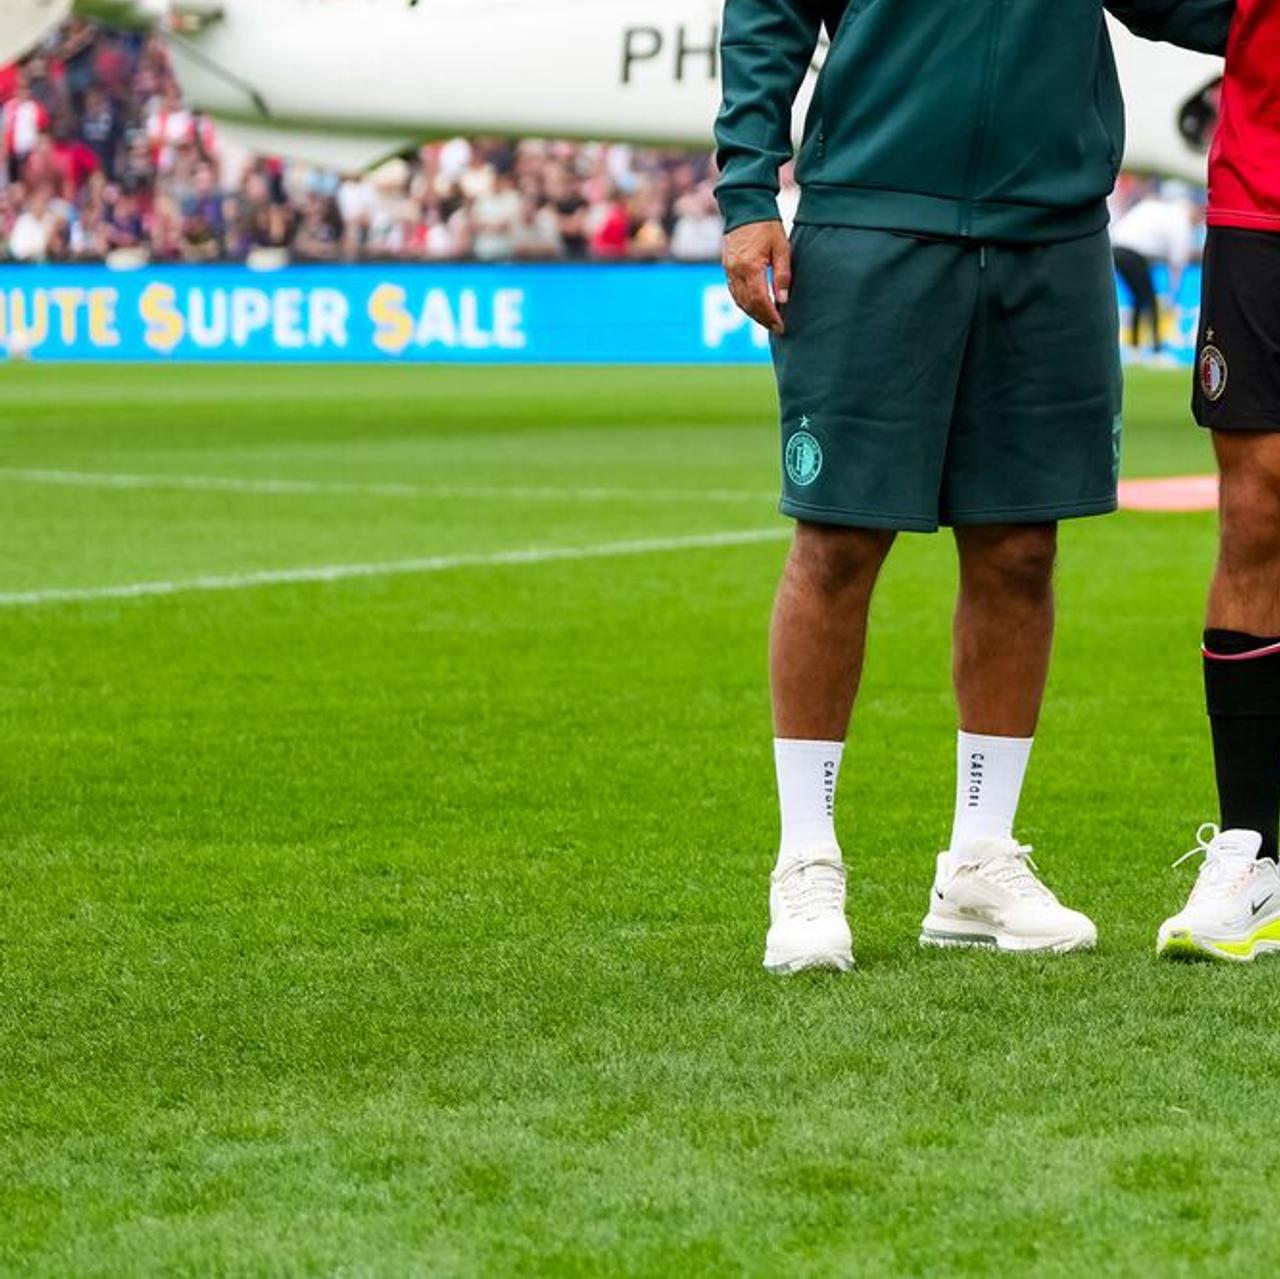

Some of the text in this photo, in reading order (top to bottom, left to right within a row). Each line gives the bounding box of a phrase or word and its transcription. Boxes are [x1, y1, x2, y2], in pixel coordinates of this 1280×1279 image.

[619, 23, 719, 86] PH
[0, 280, 527, 355] UTE SUPER SALE
